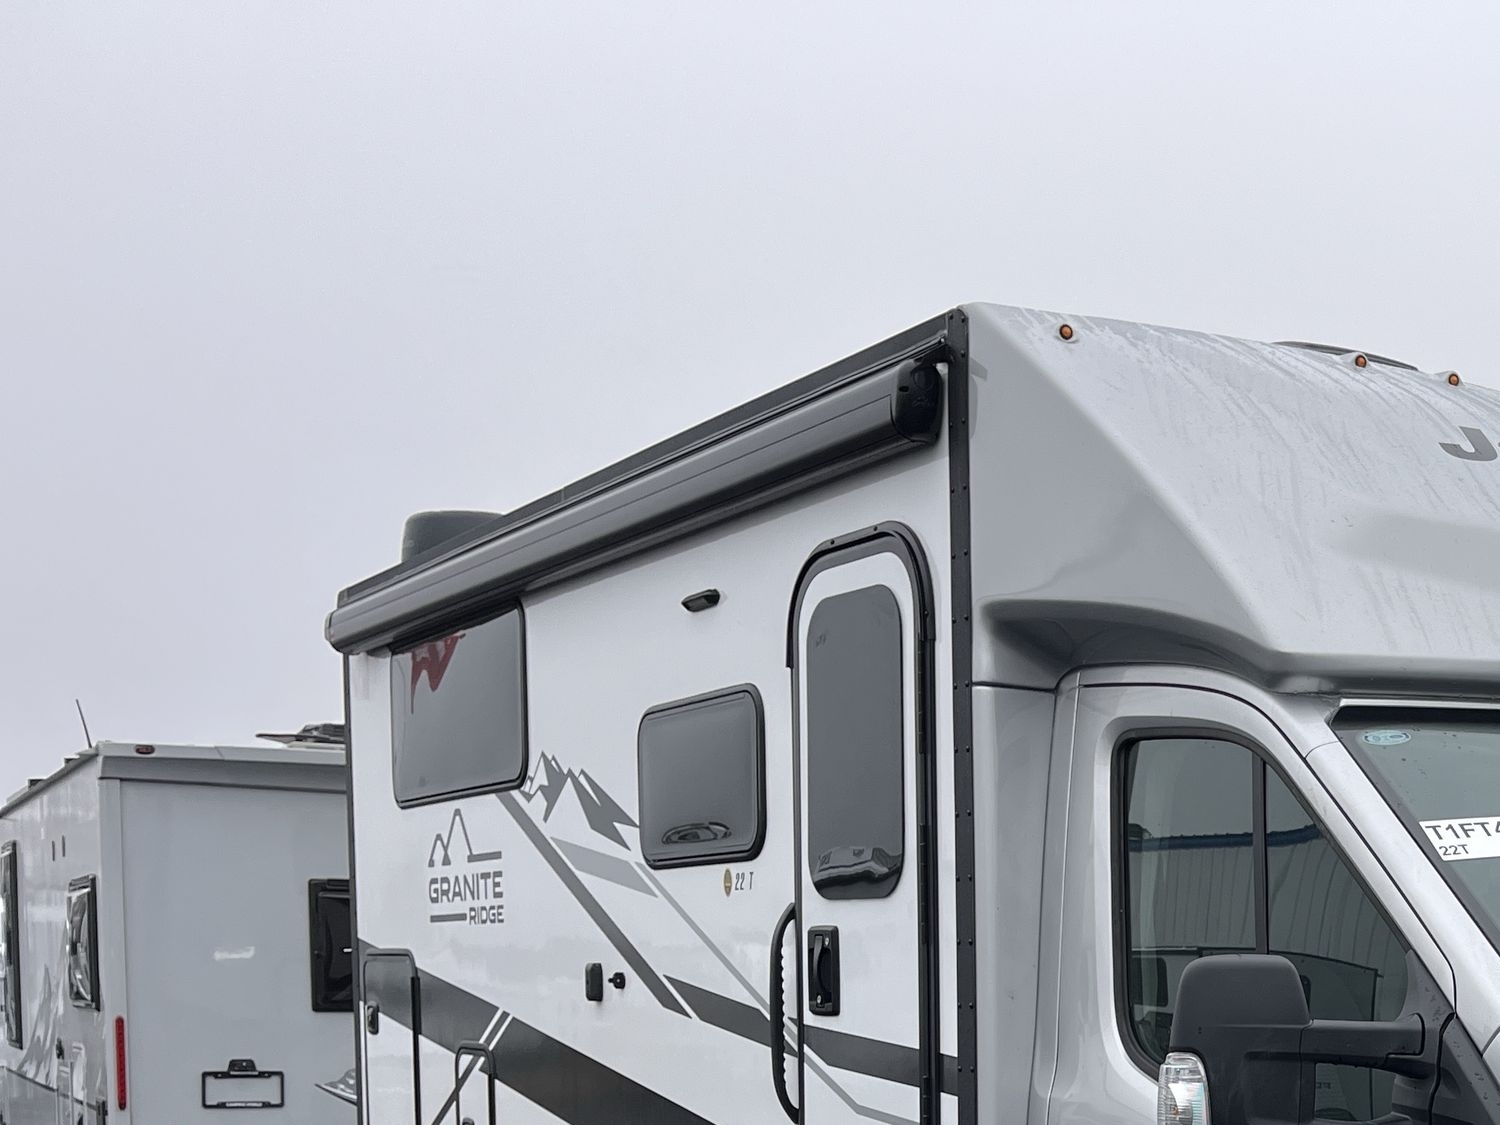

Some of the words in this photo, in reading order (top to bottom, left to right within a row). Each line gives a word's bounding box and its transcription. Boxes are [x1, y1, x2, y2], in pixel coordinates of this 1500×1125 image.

[1439, 844, 1470, 856] 22T
[428, 871, 504, 904] GRANITE
[735, 872, 745, 890] 22
[468, 905, 505, 925] RIDGE
